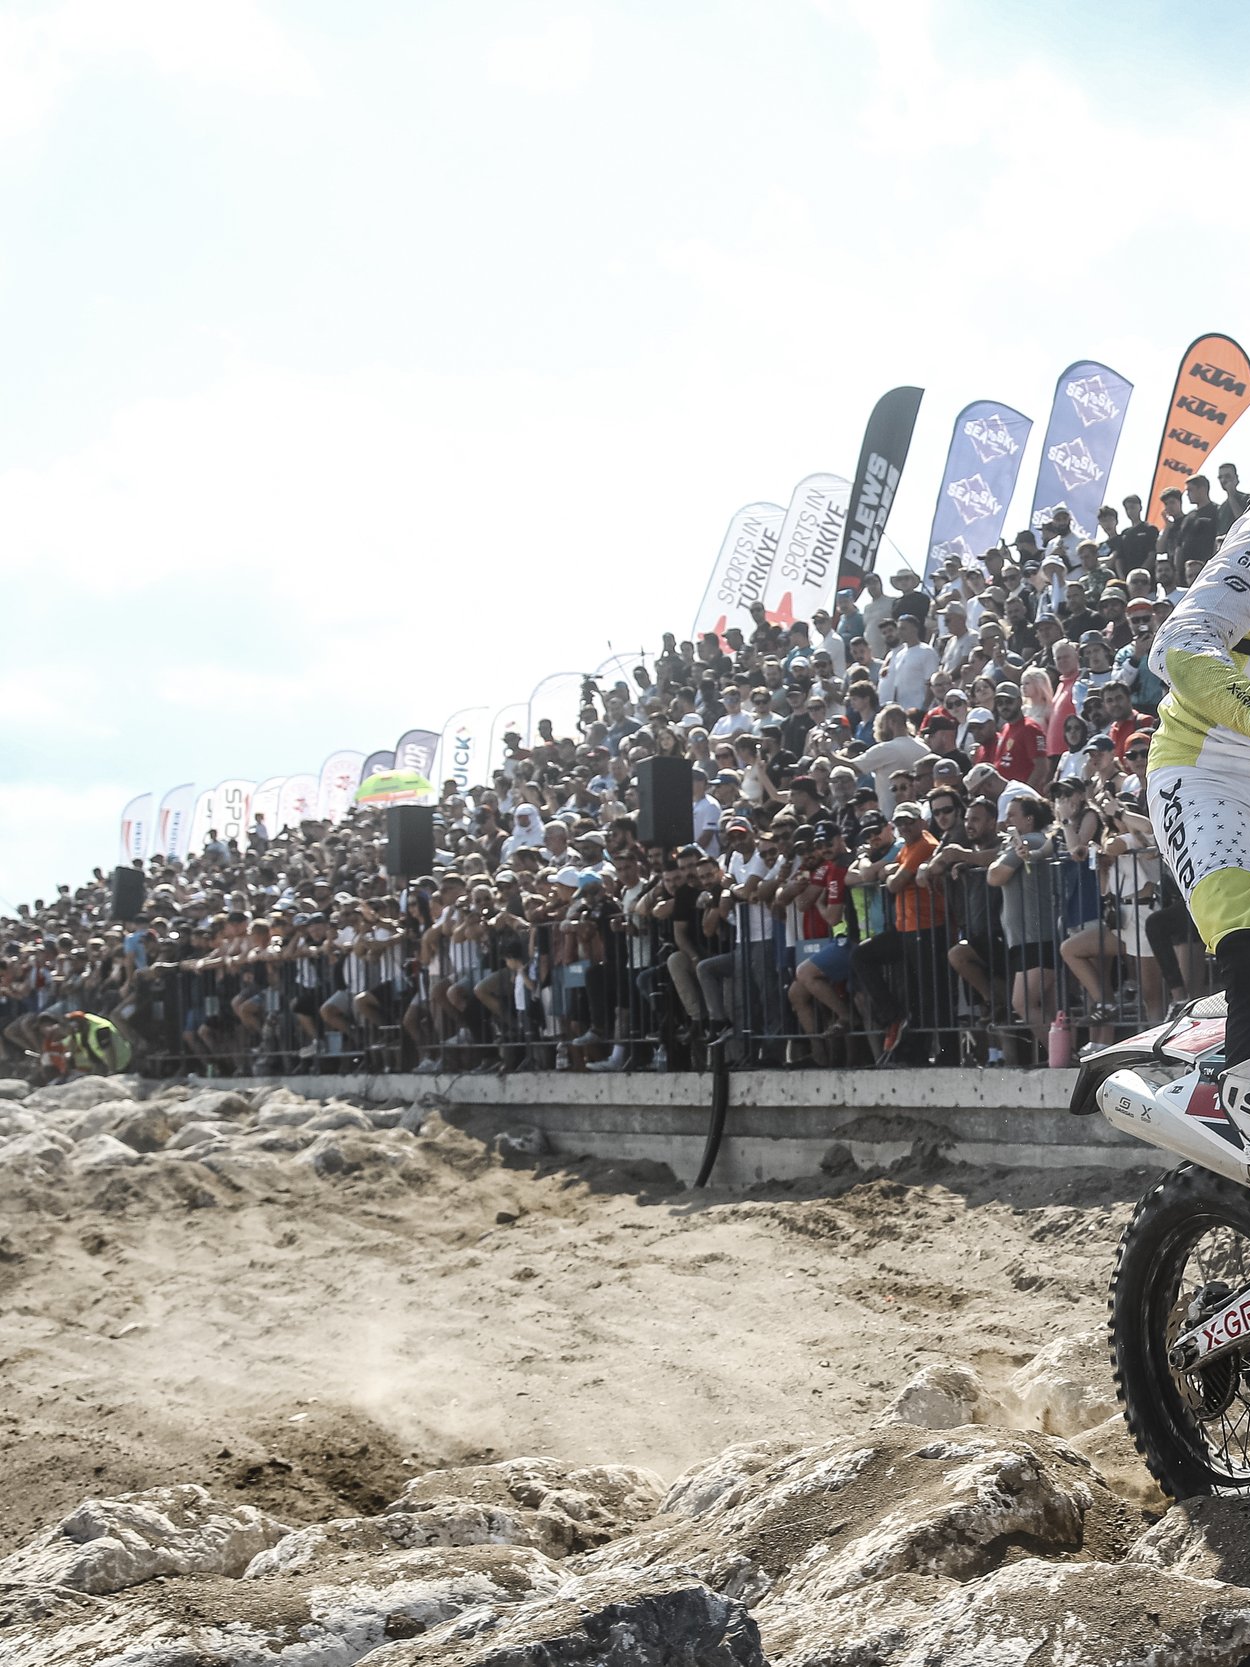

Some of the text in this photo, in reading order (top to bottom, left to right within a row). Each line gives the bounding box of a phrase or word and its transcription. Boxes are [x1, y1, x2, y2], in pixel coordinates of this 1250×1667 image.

[1189, 363, 1247, 397] KTM
[1065, 381, 1090, 407] SEA
[1097, 393, 1120, 419] SKY
[1176, 395, 1227, 425] KTM
[963, 420, 988, 445] SEA
[996, 430, 1019, 454] SKY
[1168, 428, 1209, 452] KTM
[1048, 446, 1072, 471] SEA
[1080, 455, 1104, 481] SKY
[1163, 458, 1193, 476] KTM
[845, 452, 889, 567] PLEWS
[947, 482, 971, 506] SEA
[979, 491, 1002, 515] SKY
[780, 488, 826, 581] SPORTS IN
[718, 516, 762, 604] SPORTS IN
[452, 736, 471, 795] UICK
